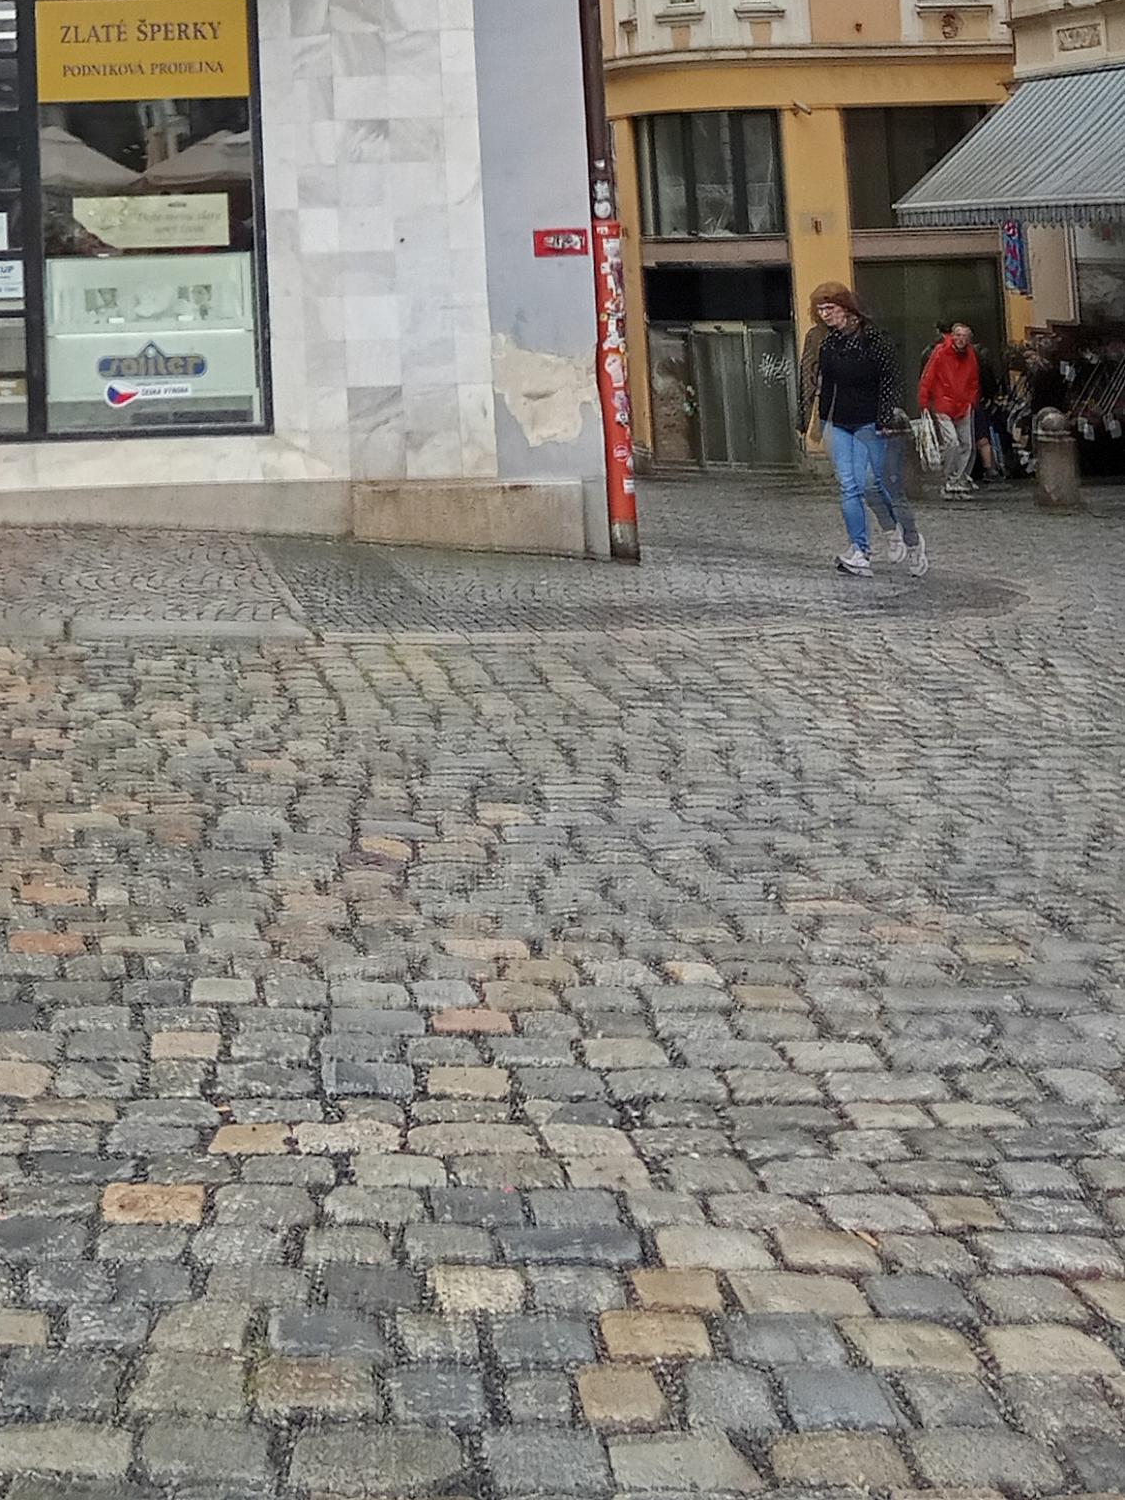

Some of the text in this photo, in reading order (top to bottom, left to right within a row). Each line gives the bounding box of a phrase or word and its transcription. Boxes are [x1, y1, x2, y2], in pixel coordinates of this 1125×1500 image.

[59, 18, 222, 44] ZLATÉ ŠPERKY
[62, 60, 224, 78] PODNIKOVÁ PRODEJNA
